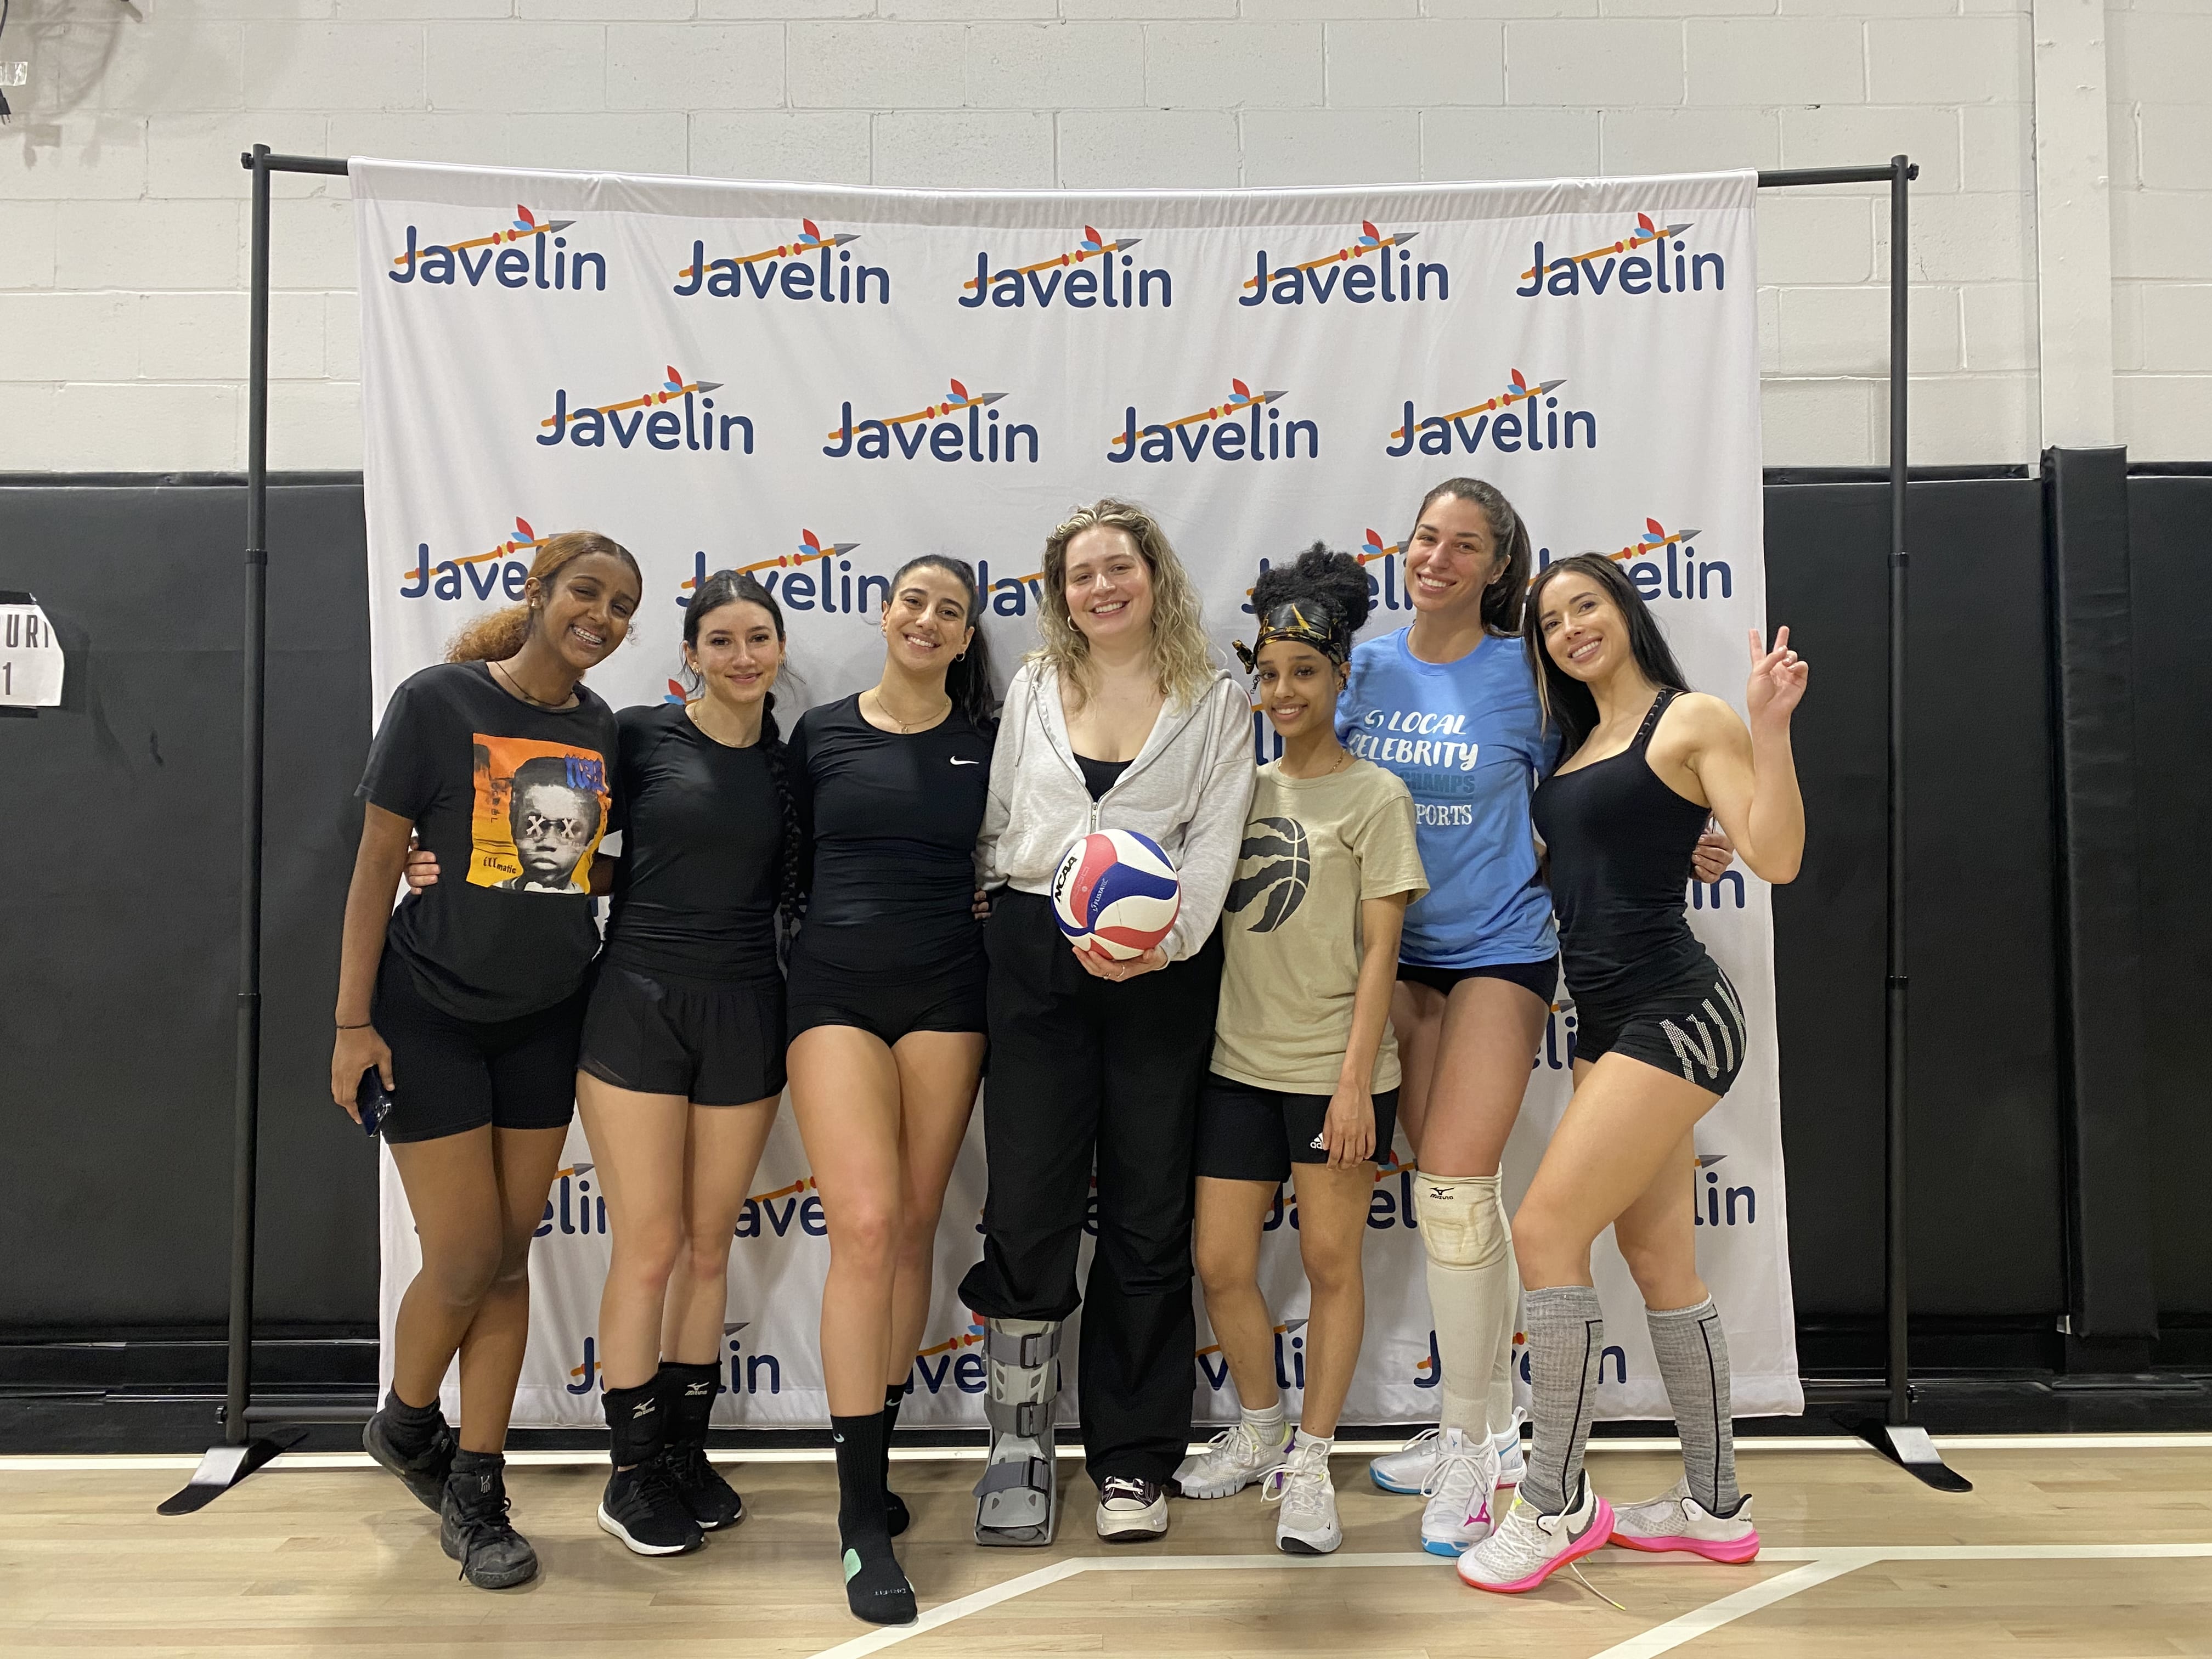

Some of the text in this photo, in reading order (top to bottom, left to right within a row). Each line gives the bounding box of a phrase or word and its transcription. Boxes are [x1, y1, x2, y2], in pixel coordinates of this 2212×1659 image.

[388, 225, 606, 291] Javelin
[674, 240, 889, 304] Javelin
[958, 252, 1171, 308] Javelin
[1239, 246, 1448, 306] Javelin
[1516, 237, 1724, 297] Javelin
[536, 389, 753, 454] Javelin
[823, 402, 1038, 462] Javelin
[1107, 403, 1318, 463] Javelin
[1386, 396, 1596, 457] Javelin
[400, 543, 542, 601] Jave
[2, 662, 11, 695] 1
[1387, 711, 1466, 735] LOCAL
[1415, 803, 1472, 826] PORTS
